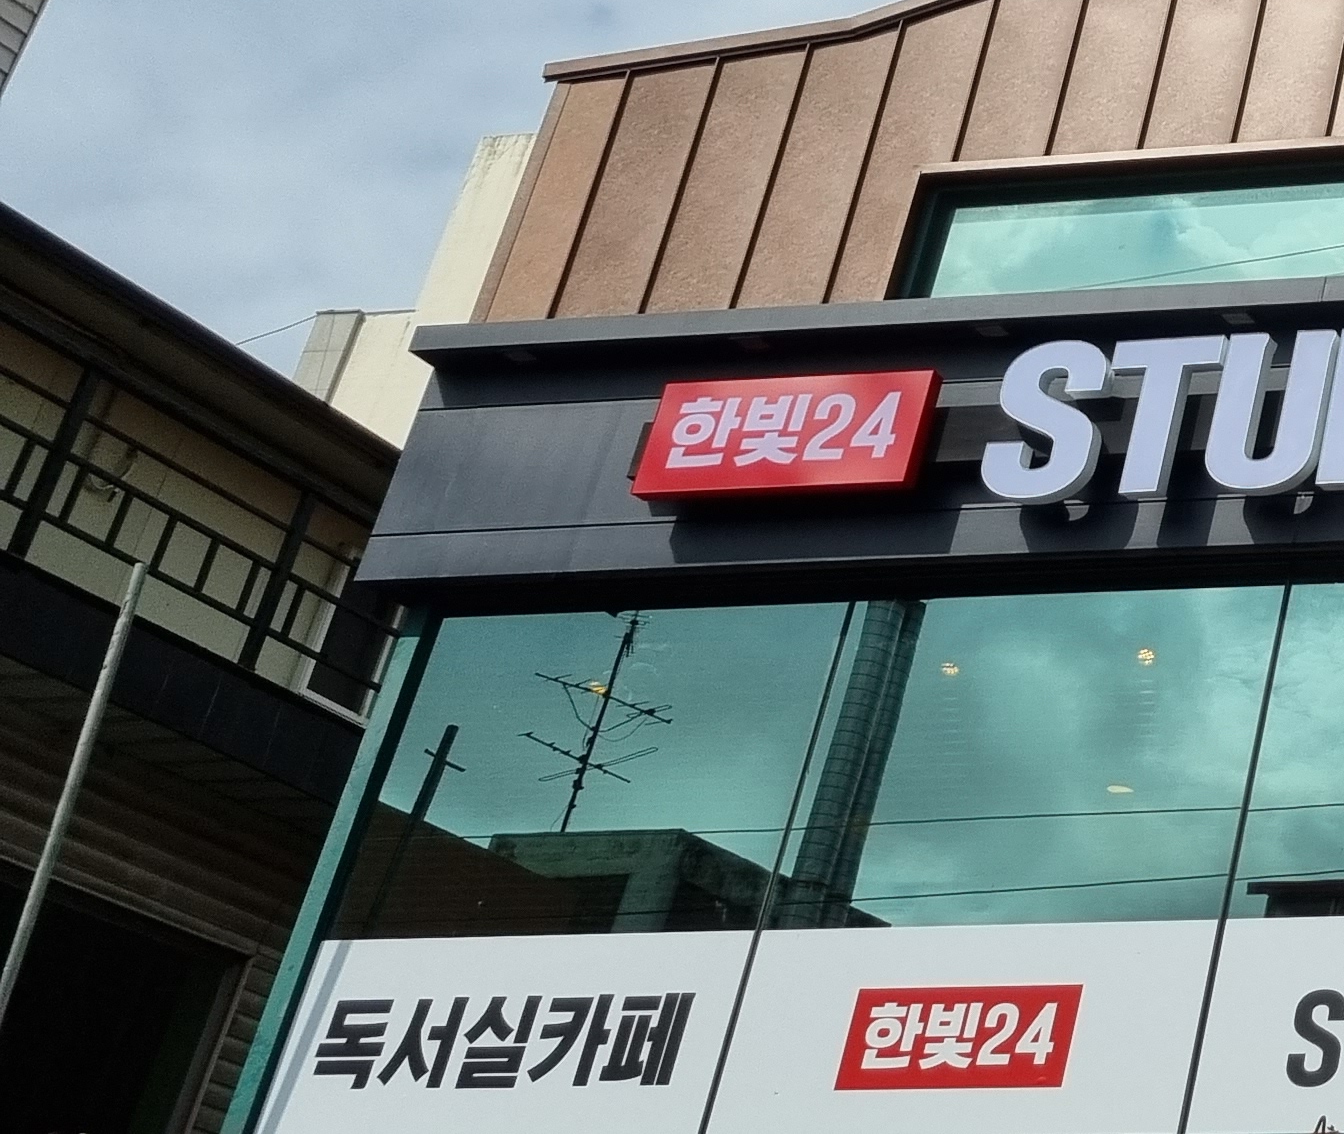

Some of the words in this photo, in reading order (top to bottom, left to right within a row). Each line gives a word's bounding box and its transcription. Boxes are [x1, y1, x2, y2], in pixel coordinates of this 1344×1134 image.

[665, 393, 898, 469] 한빛24
[313, 992, 696, 1090] 독서실카페
[863, 1001, 1055, 1069] 한빛24
